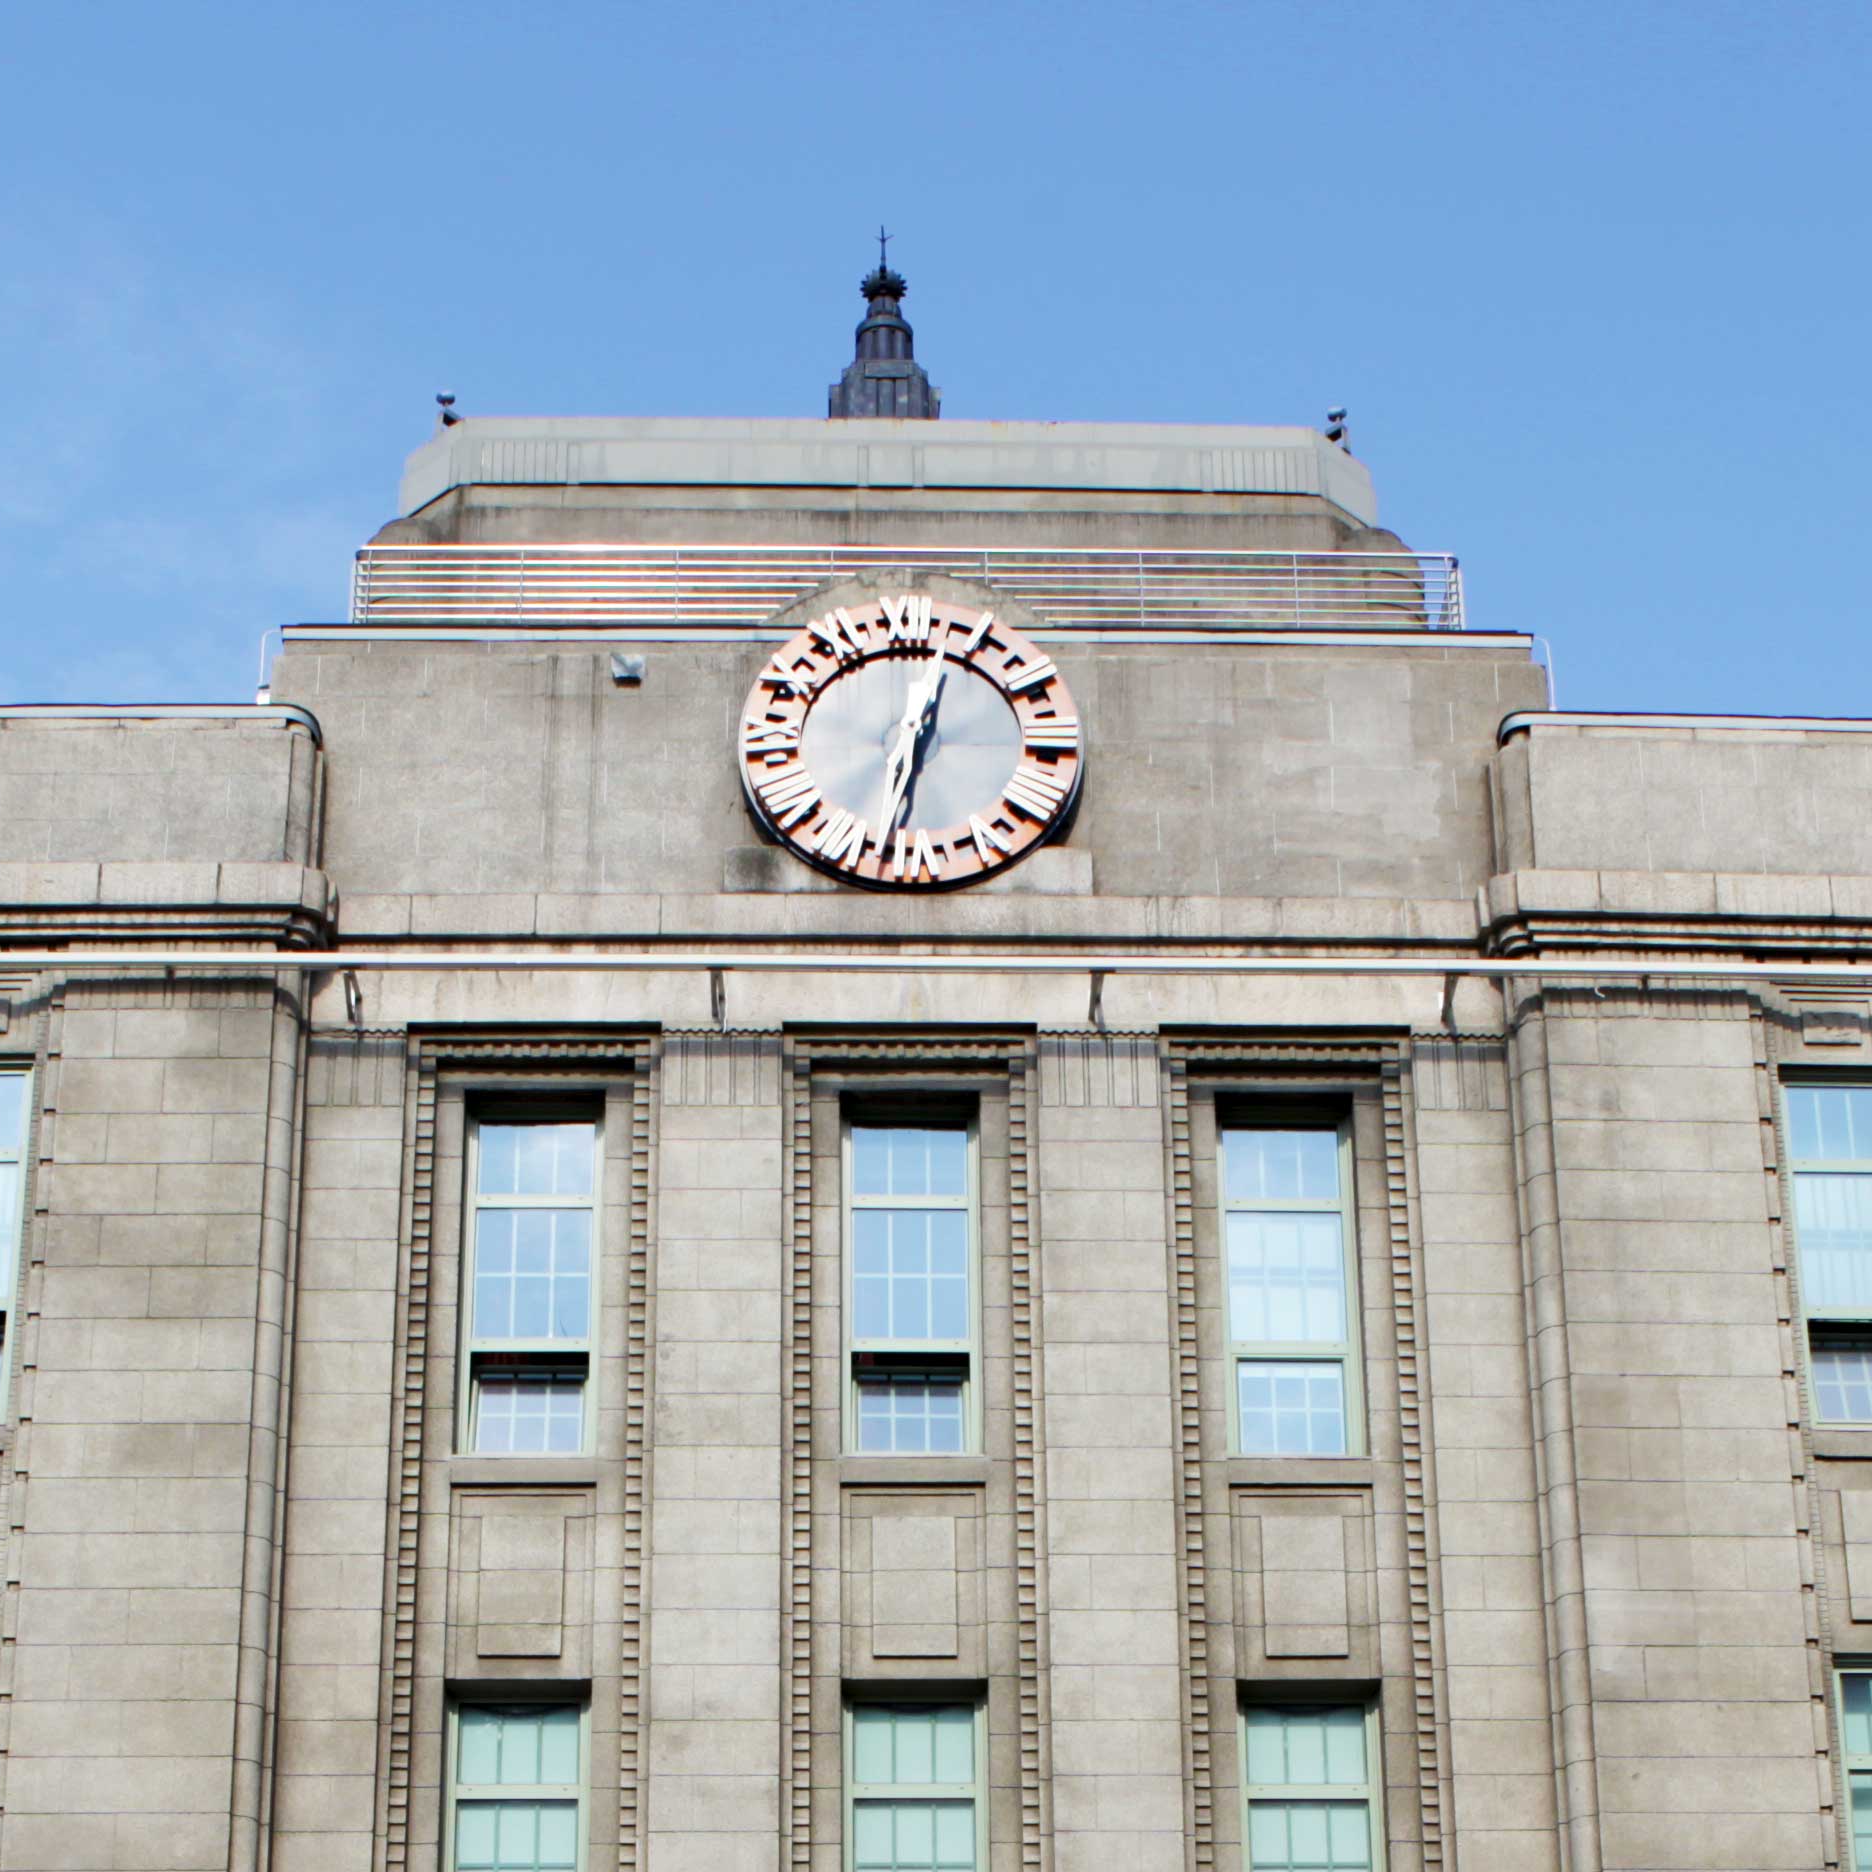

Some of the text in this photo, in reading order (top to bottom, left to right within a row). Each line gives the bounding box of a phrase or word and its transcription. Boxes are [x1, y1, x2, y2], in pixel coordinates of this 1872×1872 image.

[806, 607, 870, 660] XI
[879, 595, 932, 641] XII
[962, 610, 995, 653] I
[759, 653, 818, 696] X
[1004, 655, 1058, 691] II
[744, 715, 800, 753] IX
[1024, 716, 1078, 747] III
[753, 764, 822, 828] VIII
[812, 808, 868, 867] VII
[893, 829, 940, 877] VI
[969, 814, 1012, 863] V
